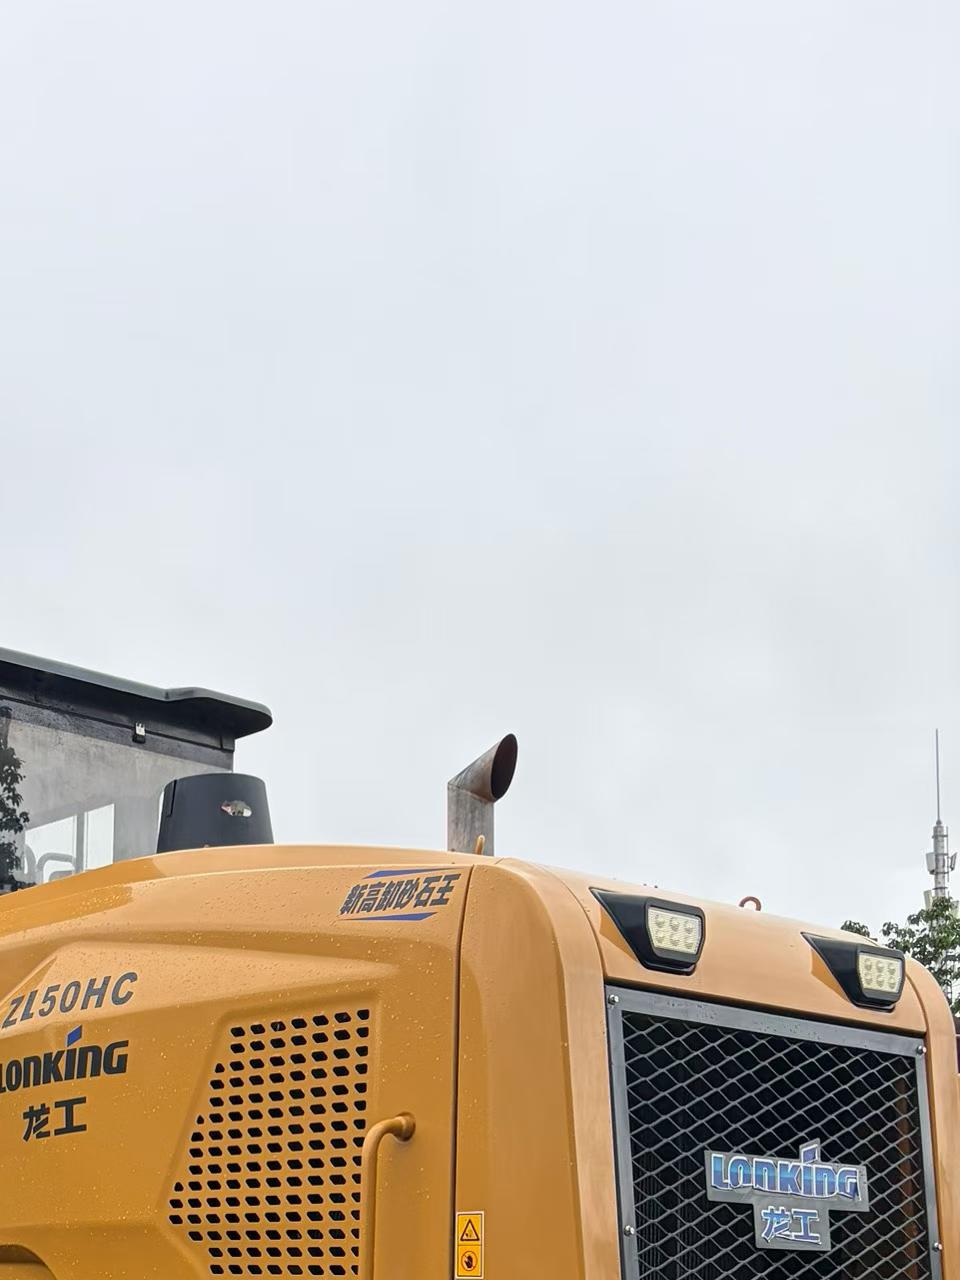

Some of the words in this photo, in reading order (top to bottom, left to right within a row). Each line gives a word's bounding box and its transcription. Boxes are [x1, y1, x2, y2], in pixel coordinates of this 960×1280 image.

[1, 971, 138, 1029] ZL50HC
[22, 1096, 88, 1143] 龙工
[760, 1205, 822, 1245] 龙工
